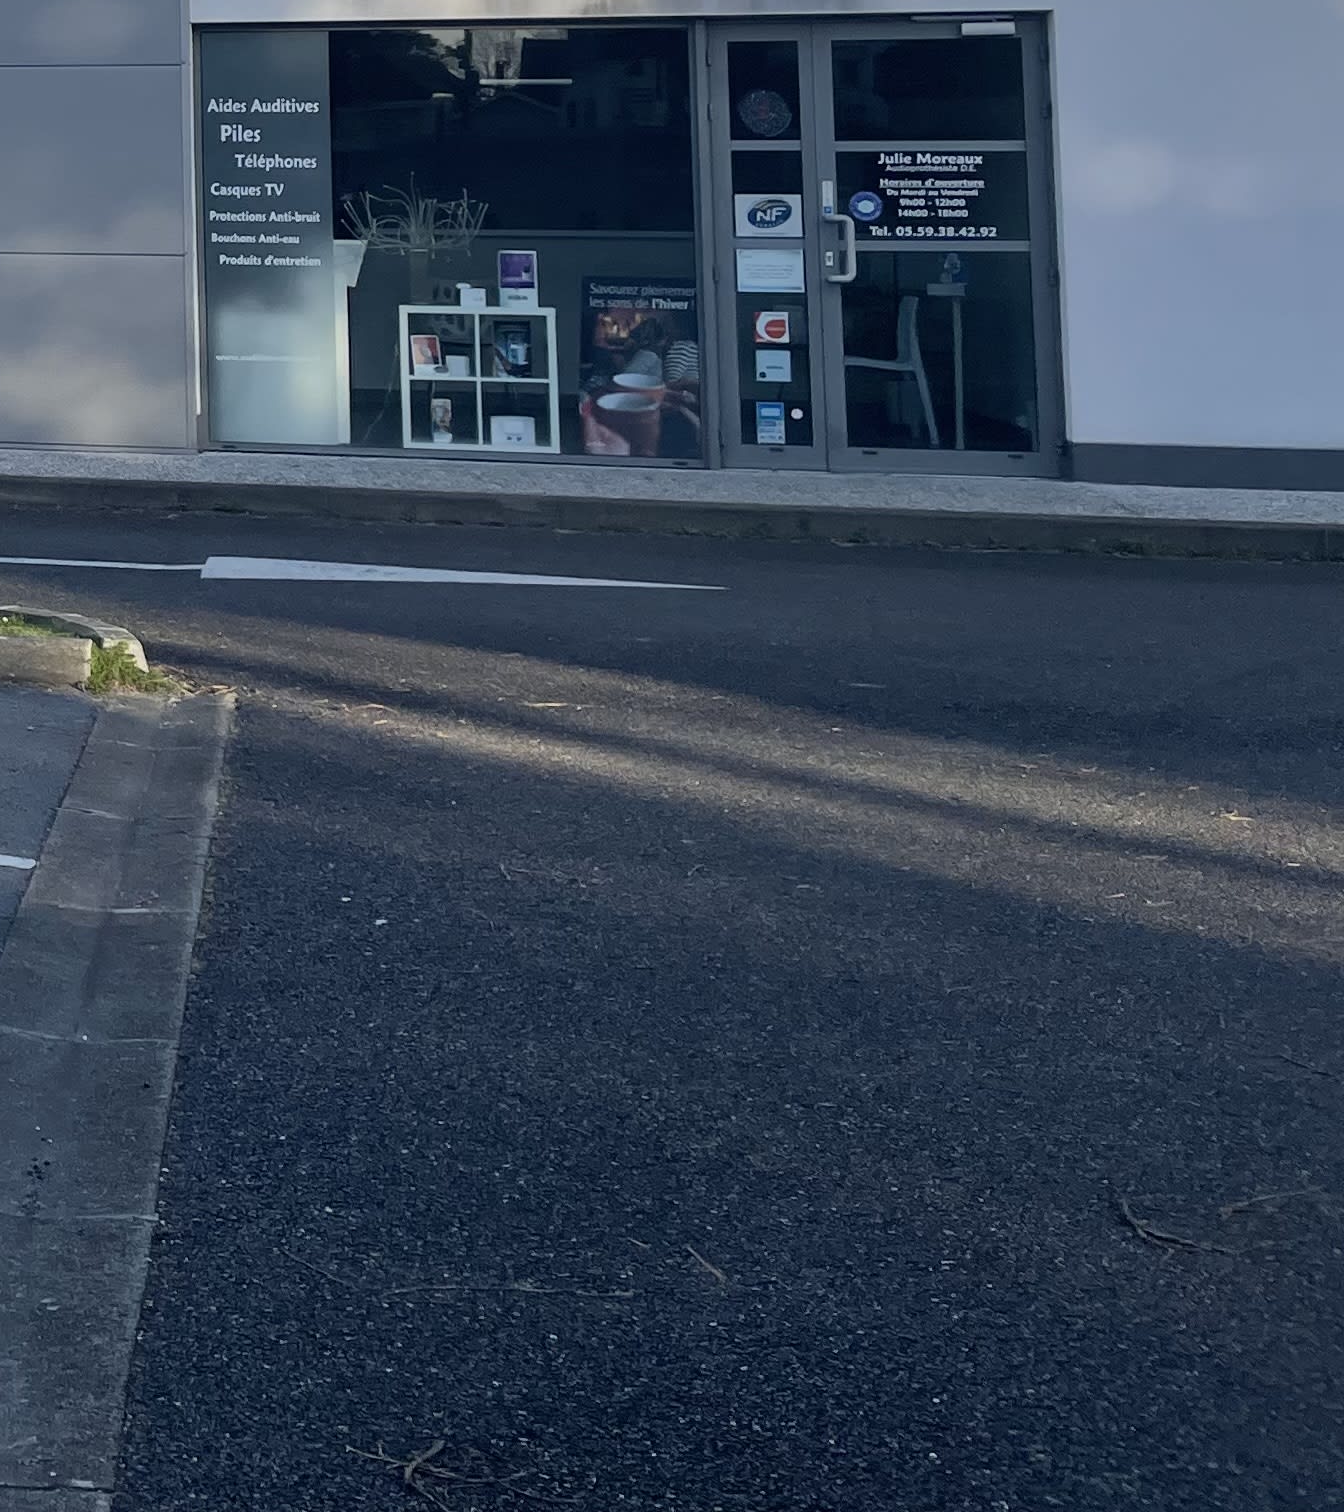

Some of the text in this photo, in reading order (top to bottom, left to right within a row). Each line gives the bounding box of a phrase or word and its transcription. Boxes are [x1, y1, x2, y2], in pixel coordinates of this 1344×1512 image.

[207, 98, 320, 113] Aides Auditives
[220, 124, 261, 143] Piles
[234, 153, 318, 172] Téléphones
[877, 152, 983, 165] Julie Moreaux
[210, 183, 285, 199] Casques TV
[209, 210, 321, 223] Protections Anti-bruit
[756, 207, 787, 222] NF
[869, 226, 998, 237] Tel. 05.59.38.42.92
[219, 254, 262, 265] Produits
